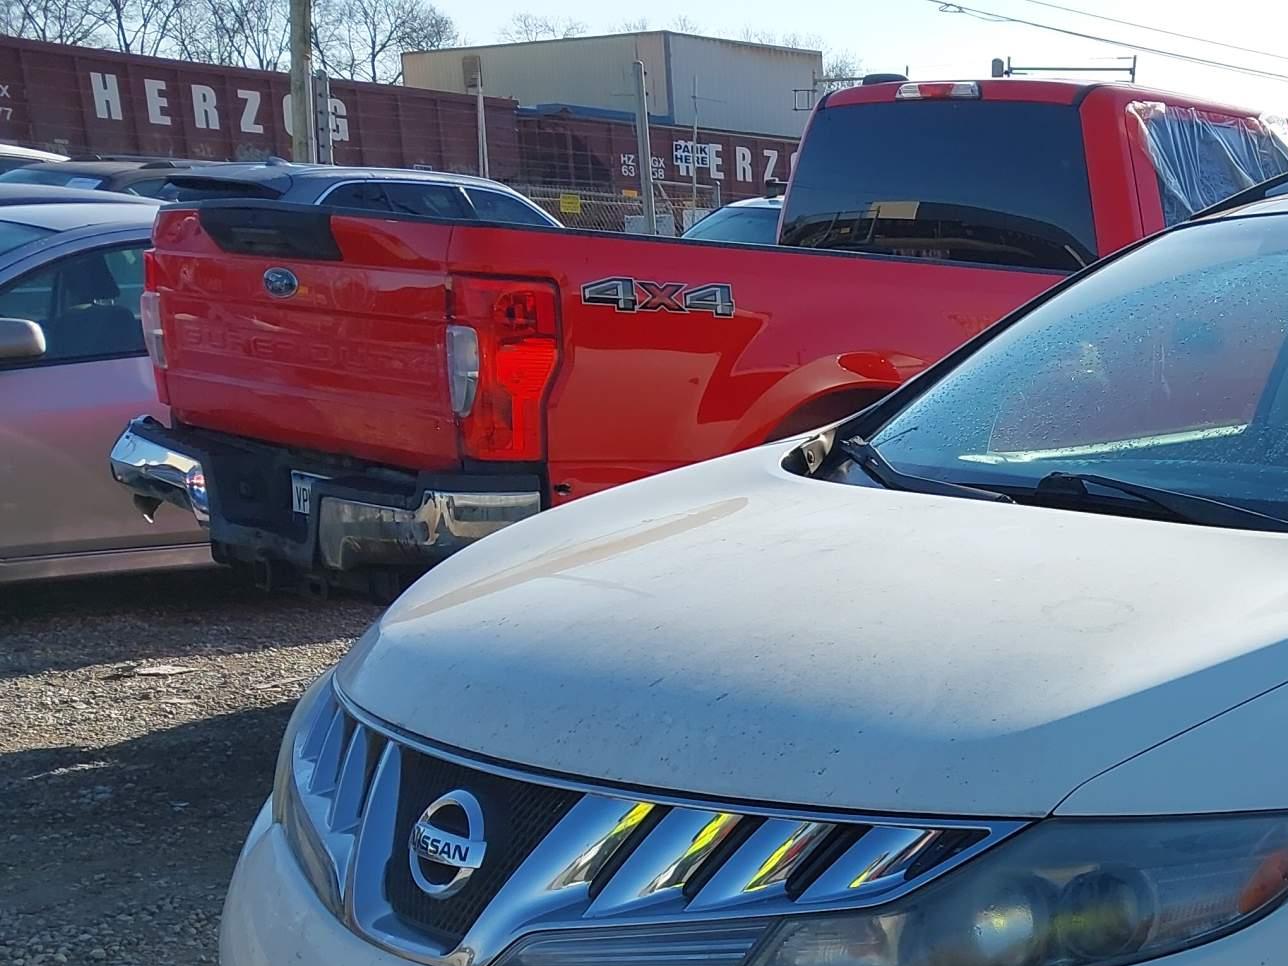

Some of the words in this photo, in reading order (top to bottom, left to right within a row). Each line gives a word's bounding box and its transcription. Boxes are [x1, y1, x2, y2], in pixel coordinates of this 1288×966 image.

[675, 143, 708, 155] PARK
[675, 154, 708, 165] HERE
[413, 825, 470, 863] NISSAN
